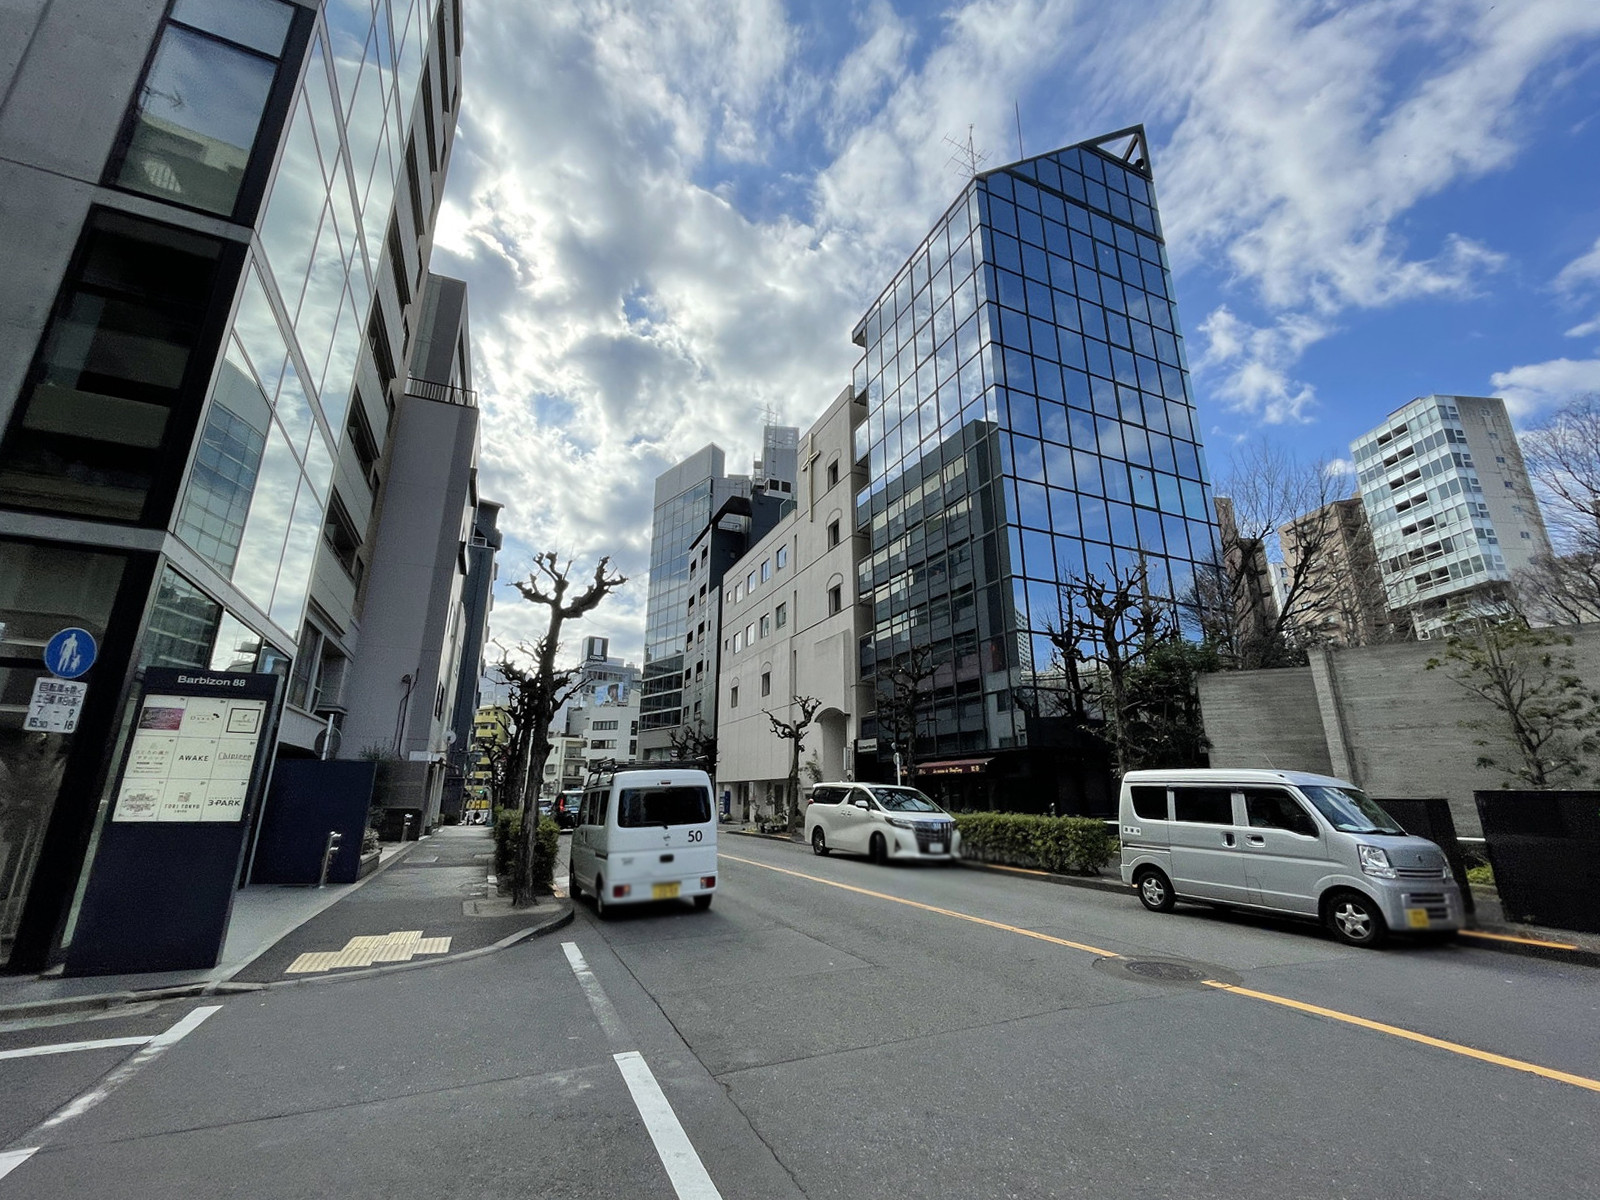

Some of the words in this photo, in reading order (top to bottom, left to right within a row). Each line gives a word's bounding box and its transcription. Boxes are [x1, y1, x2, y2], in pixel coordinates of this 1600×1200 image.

[177, 675, 231, 685] Barbizon
[233, 679, 246, 687] 88
[37, 705, 45, 715] 7
[69, 708, 75, 718] 9
[178, 754, 209, 762] AWAKE
[687, 829, 703, 843] 50
